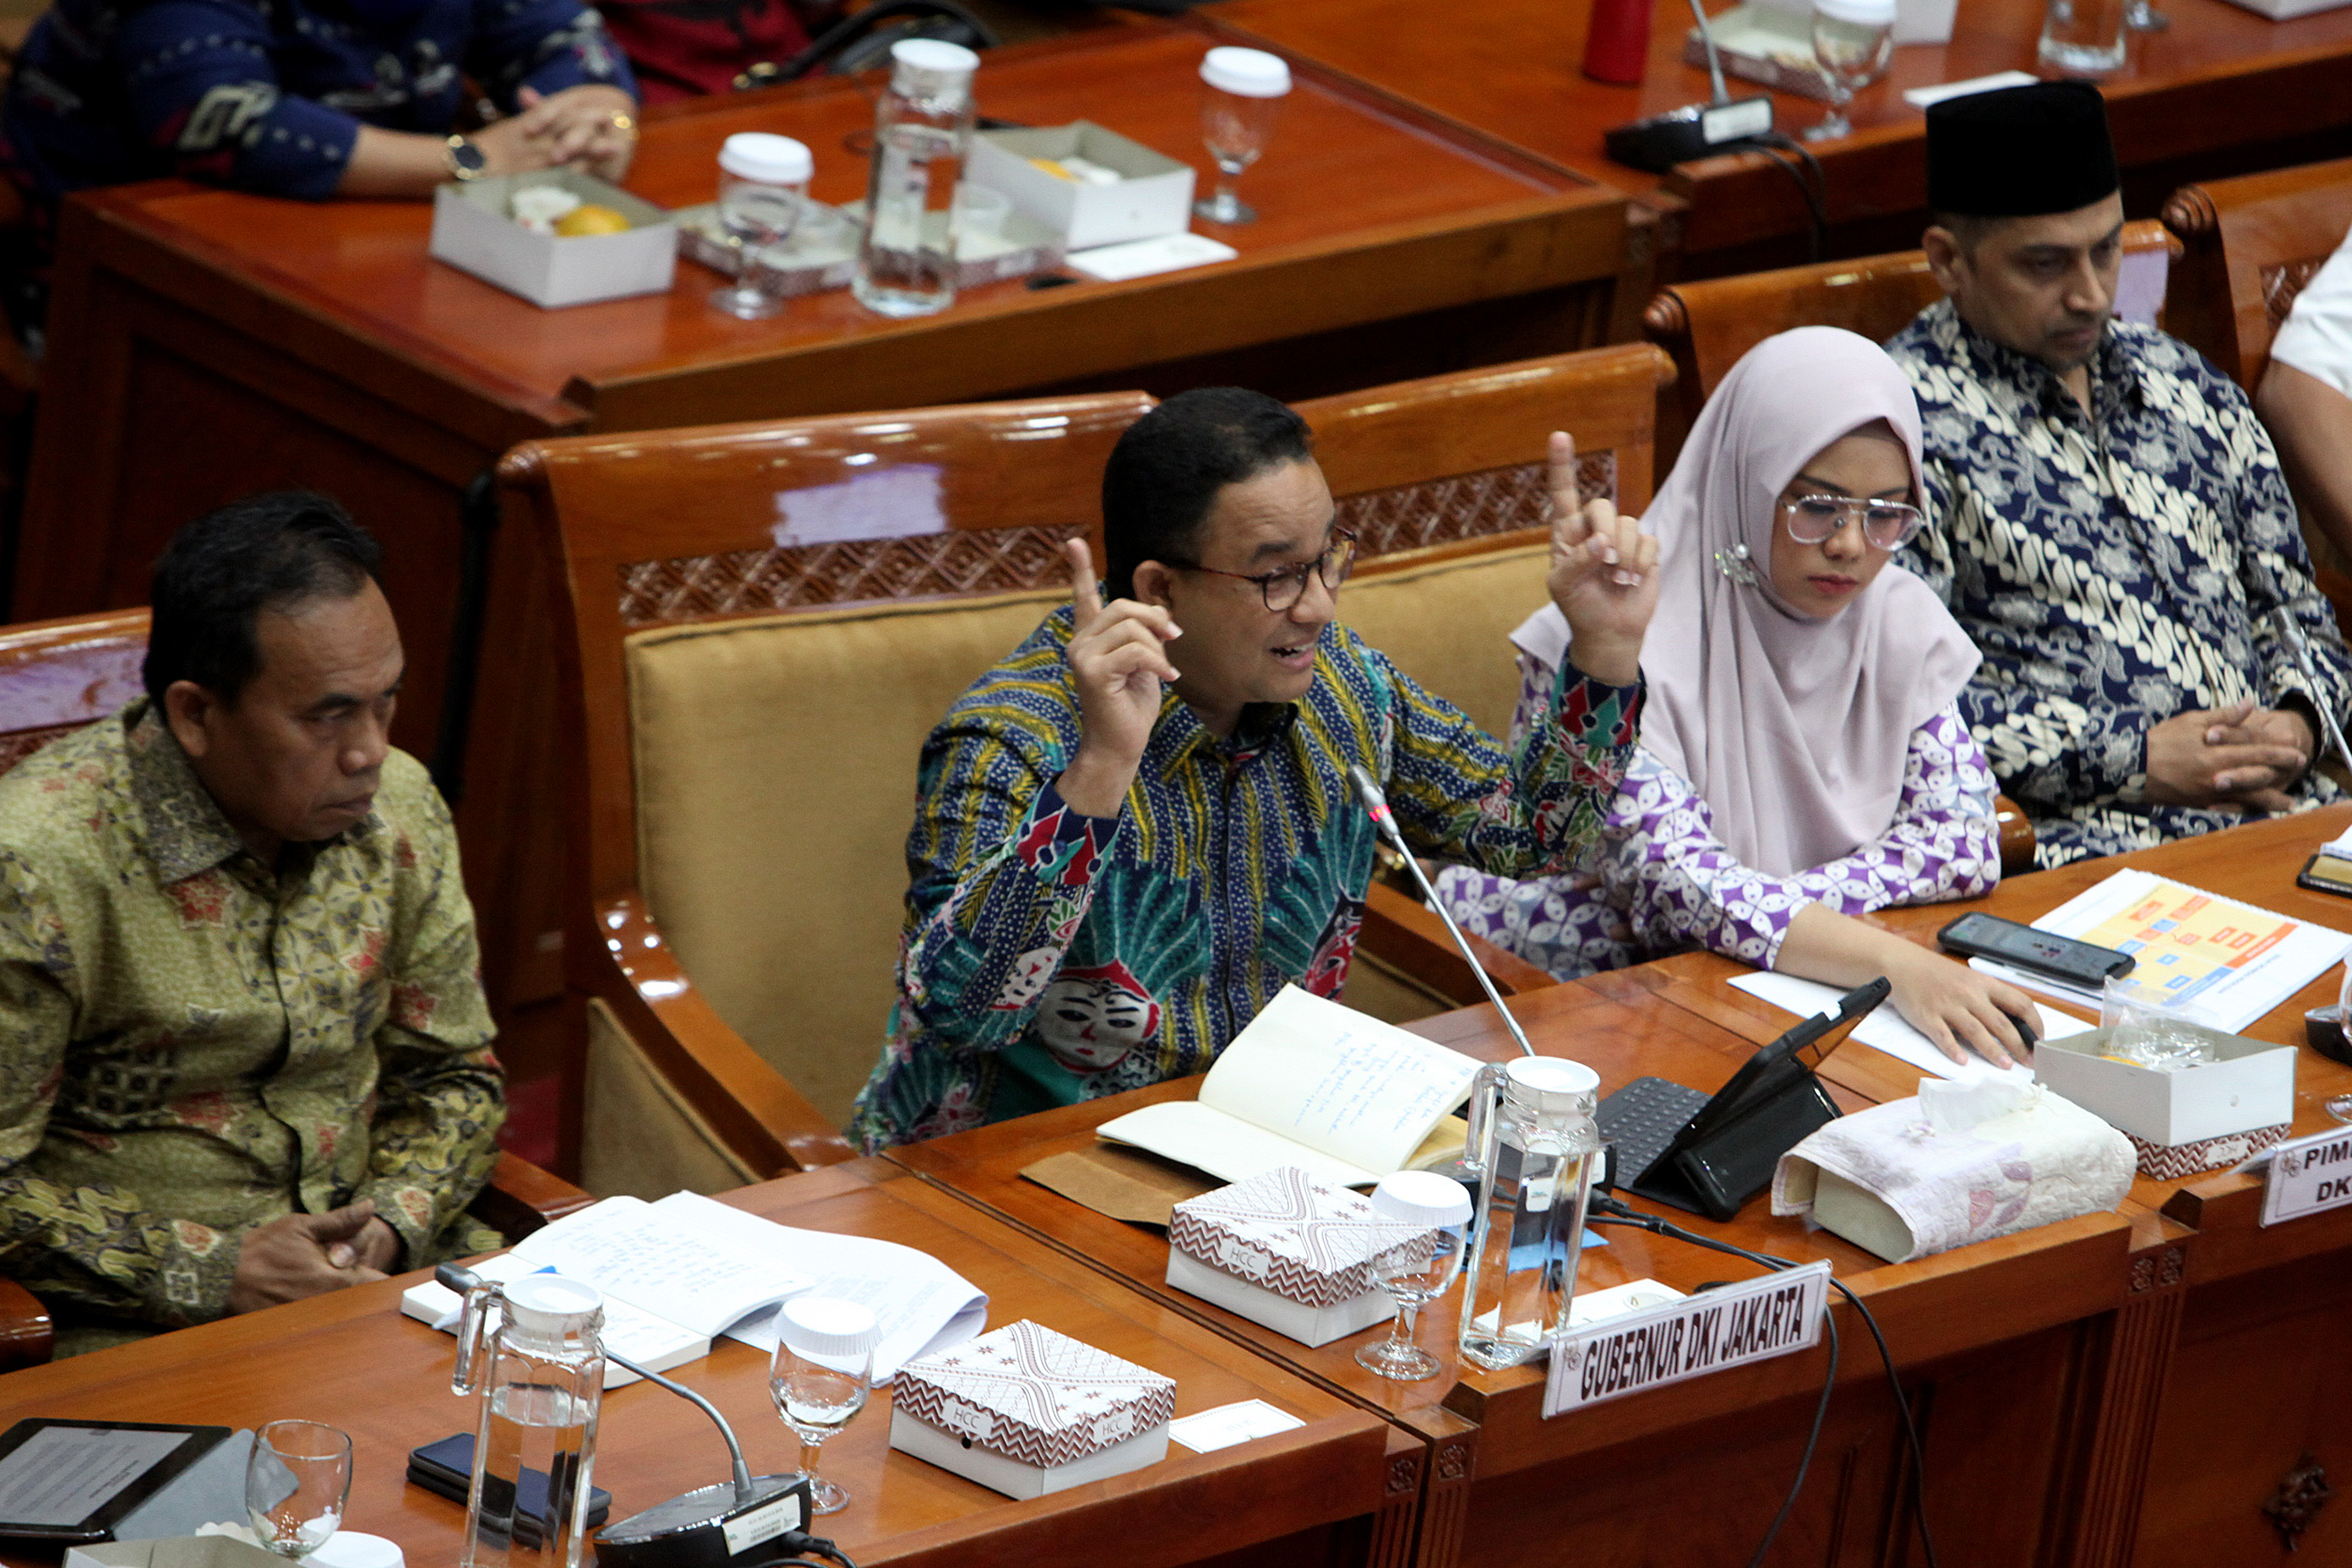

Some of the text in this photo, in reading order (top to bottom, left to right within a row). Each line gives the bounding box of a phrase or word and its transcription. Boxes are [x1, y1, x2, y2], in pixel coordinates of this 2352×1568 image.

[2304, 1141, 2352, 1169] PIM
[1230, 1247, 1257, 1268] HCC
[1581, 1283, 1805, 1401] GUBERNUR DKI JAKARTA
[953, 1407, 980, 1429] HCC
[1102, 1418, 1124, 1436] HCC
